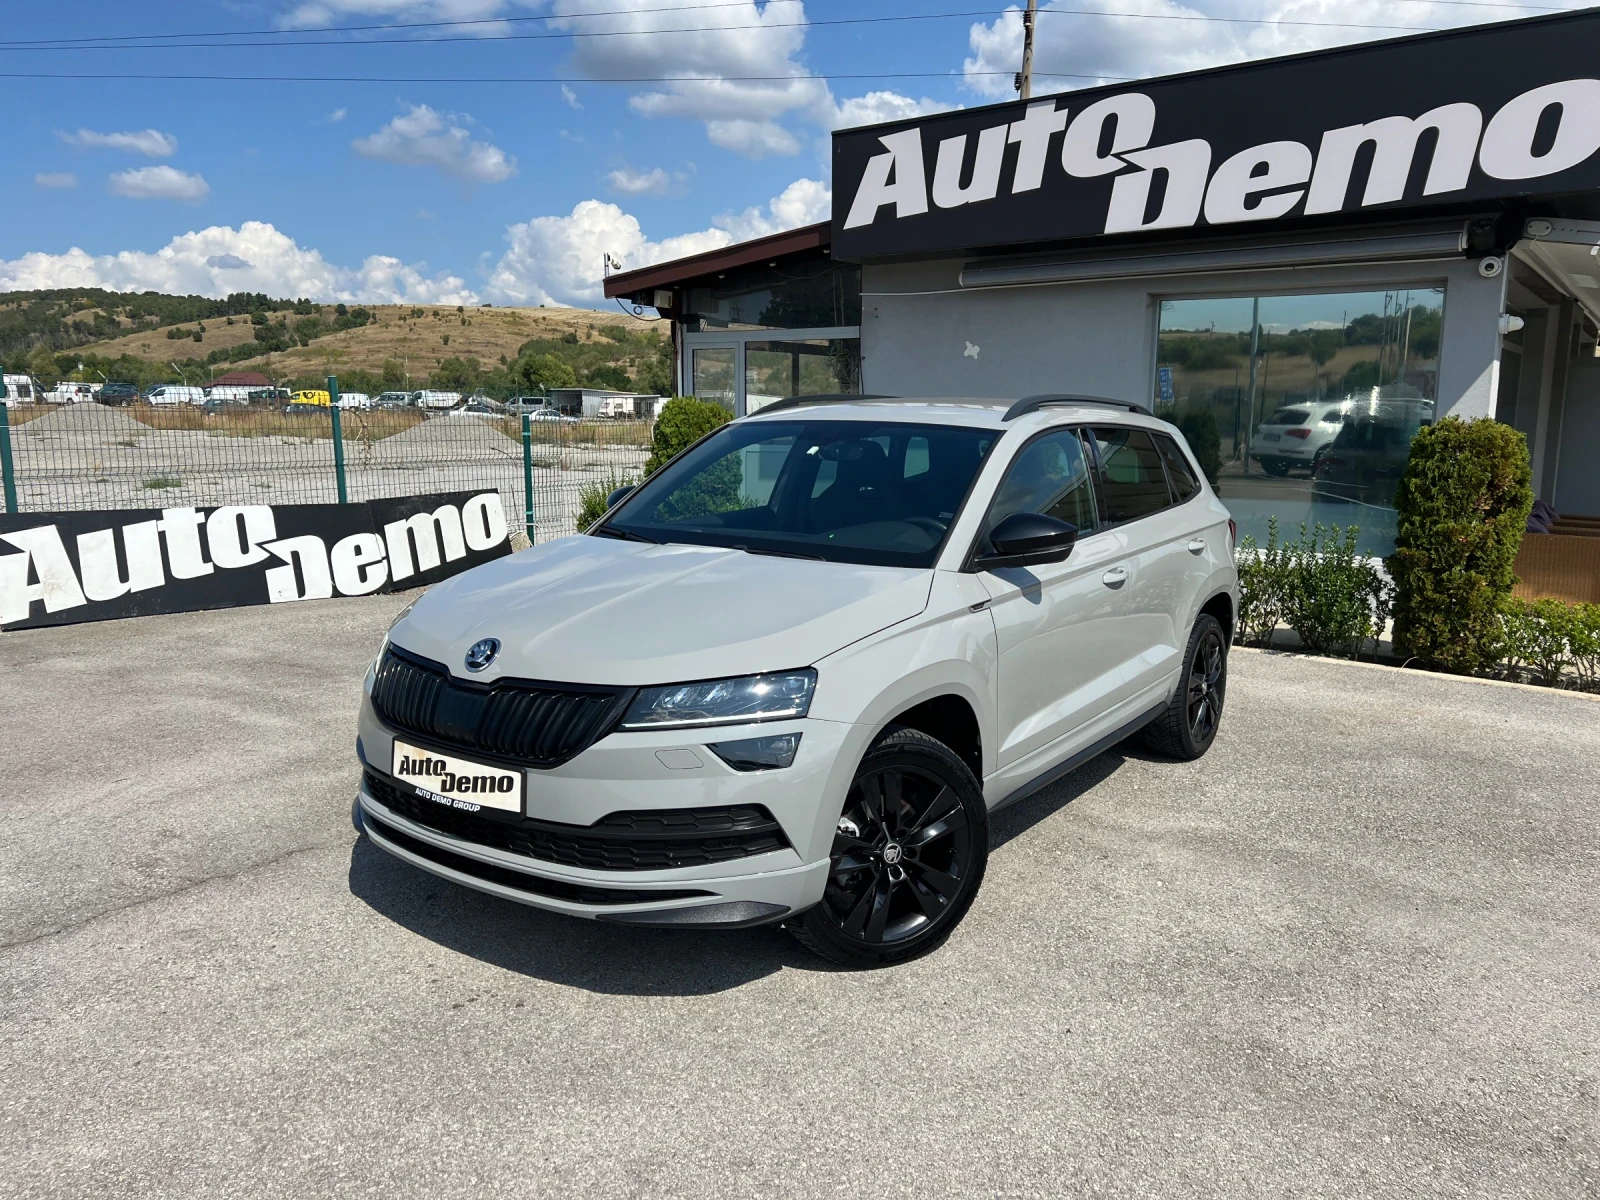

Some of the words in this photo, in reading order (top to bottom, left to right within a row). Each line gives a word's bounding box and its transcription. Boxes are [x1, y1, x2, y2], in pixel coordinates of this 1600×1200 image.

[843, 93, 1156, 230] Auto
[1104, 79, 1600, 235] Demo
[0, 504, 276, 625] Auto
[264, 493, 508, 604] Demo
[398, 755, 447, 776] Auto
[440, 772, 514, 793] Demo
[414, 787, 431, 799] AUTO
[431, 793, 452, 806] DEMO
[452, 800, 481, 812] GROUP
